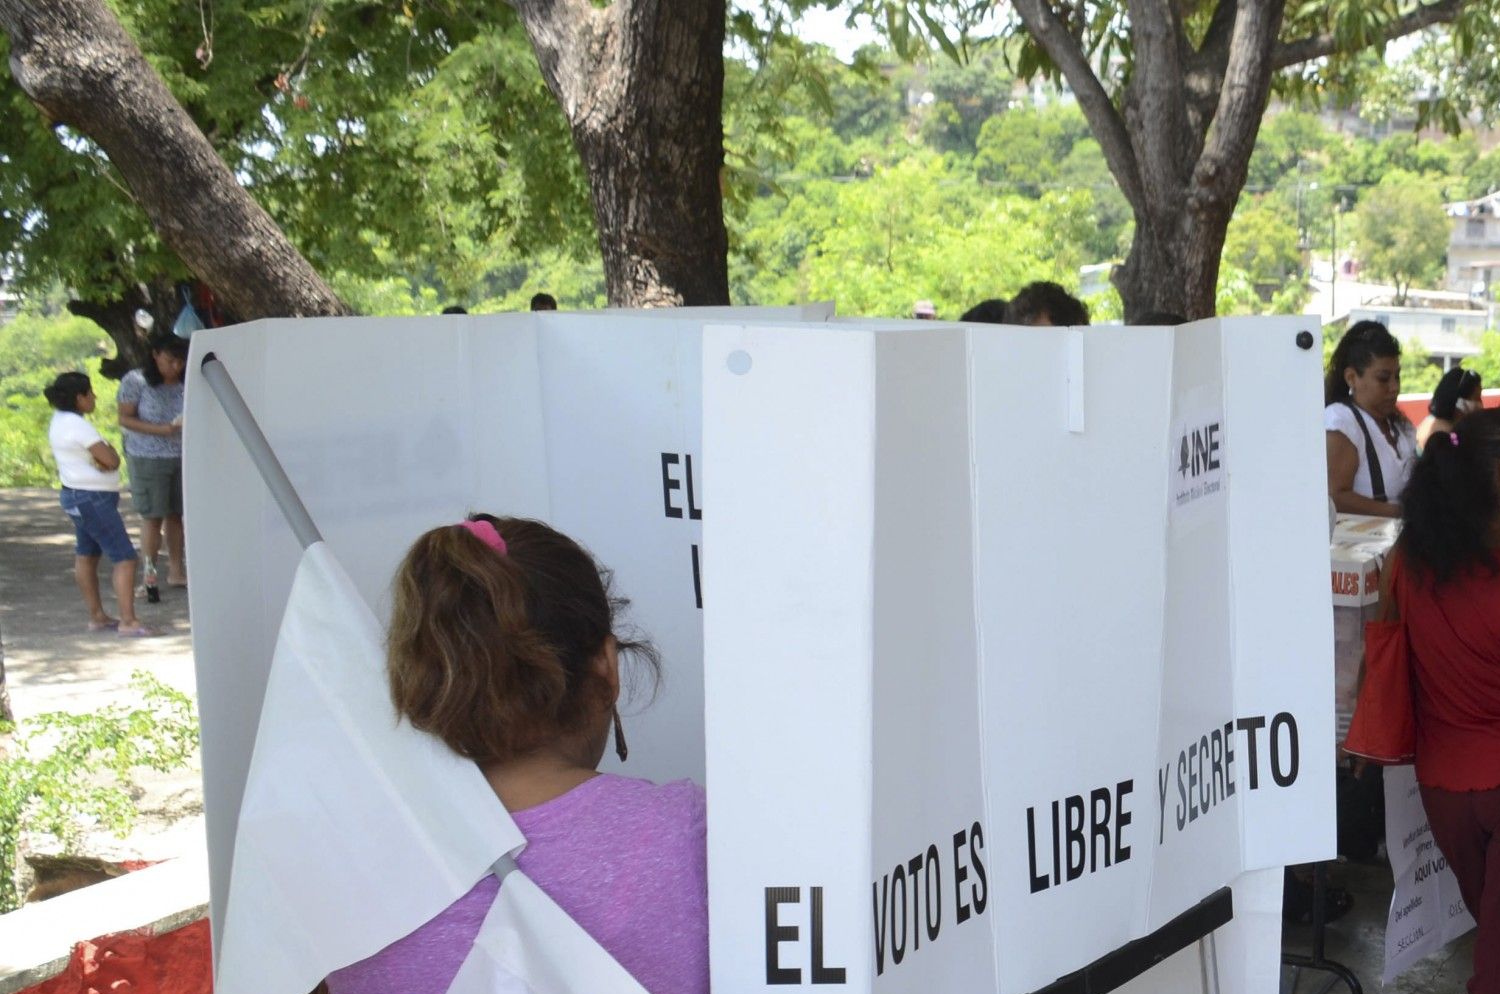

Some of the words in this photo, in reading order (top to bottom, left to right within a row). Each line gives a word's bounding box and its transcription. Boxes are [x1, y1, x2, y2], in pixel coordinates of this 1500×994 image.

[1191, 423, 1220, 478] INE
[661, 452, 702, 520] EL
[765, 886, 847, 985] EL
[872, 844, 942, 977] VOTO
[953, 821, 988, 926] ES
[1026, 779, 1134, 894] LIBRE
[1158, 763, 1170, 845] Y
[1176, 711, 1300, 832] SECRETO
